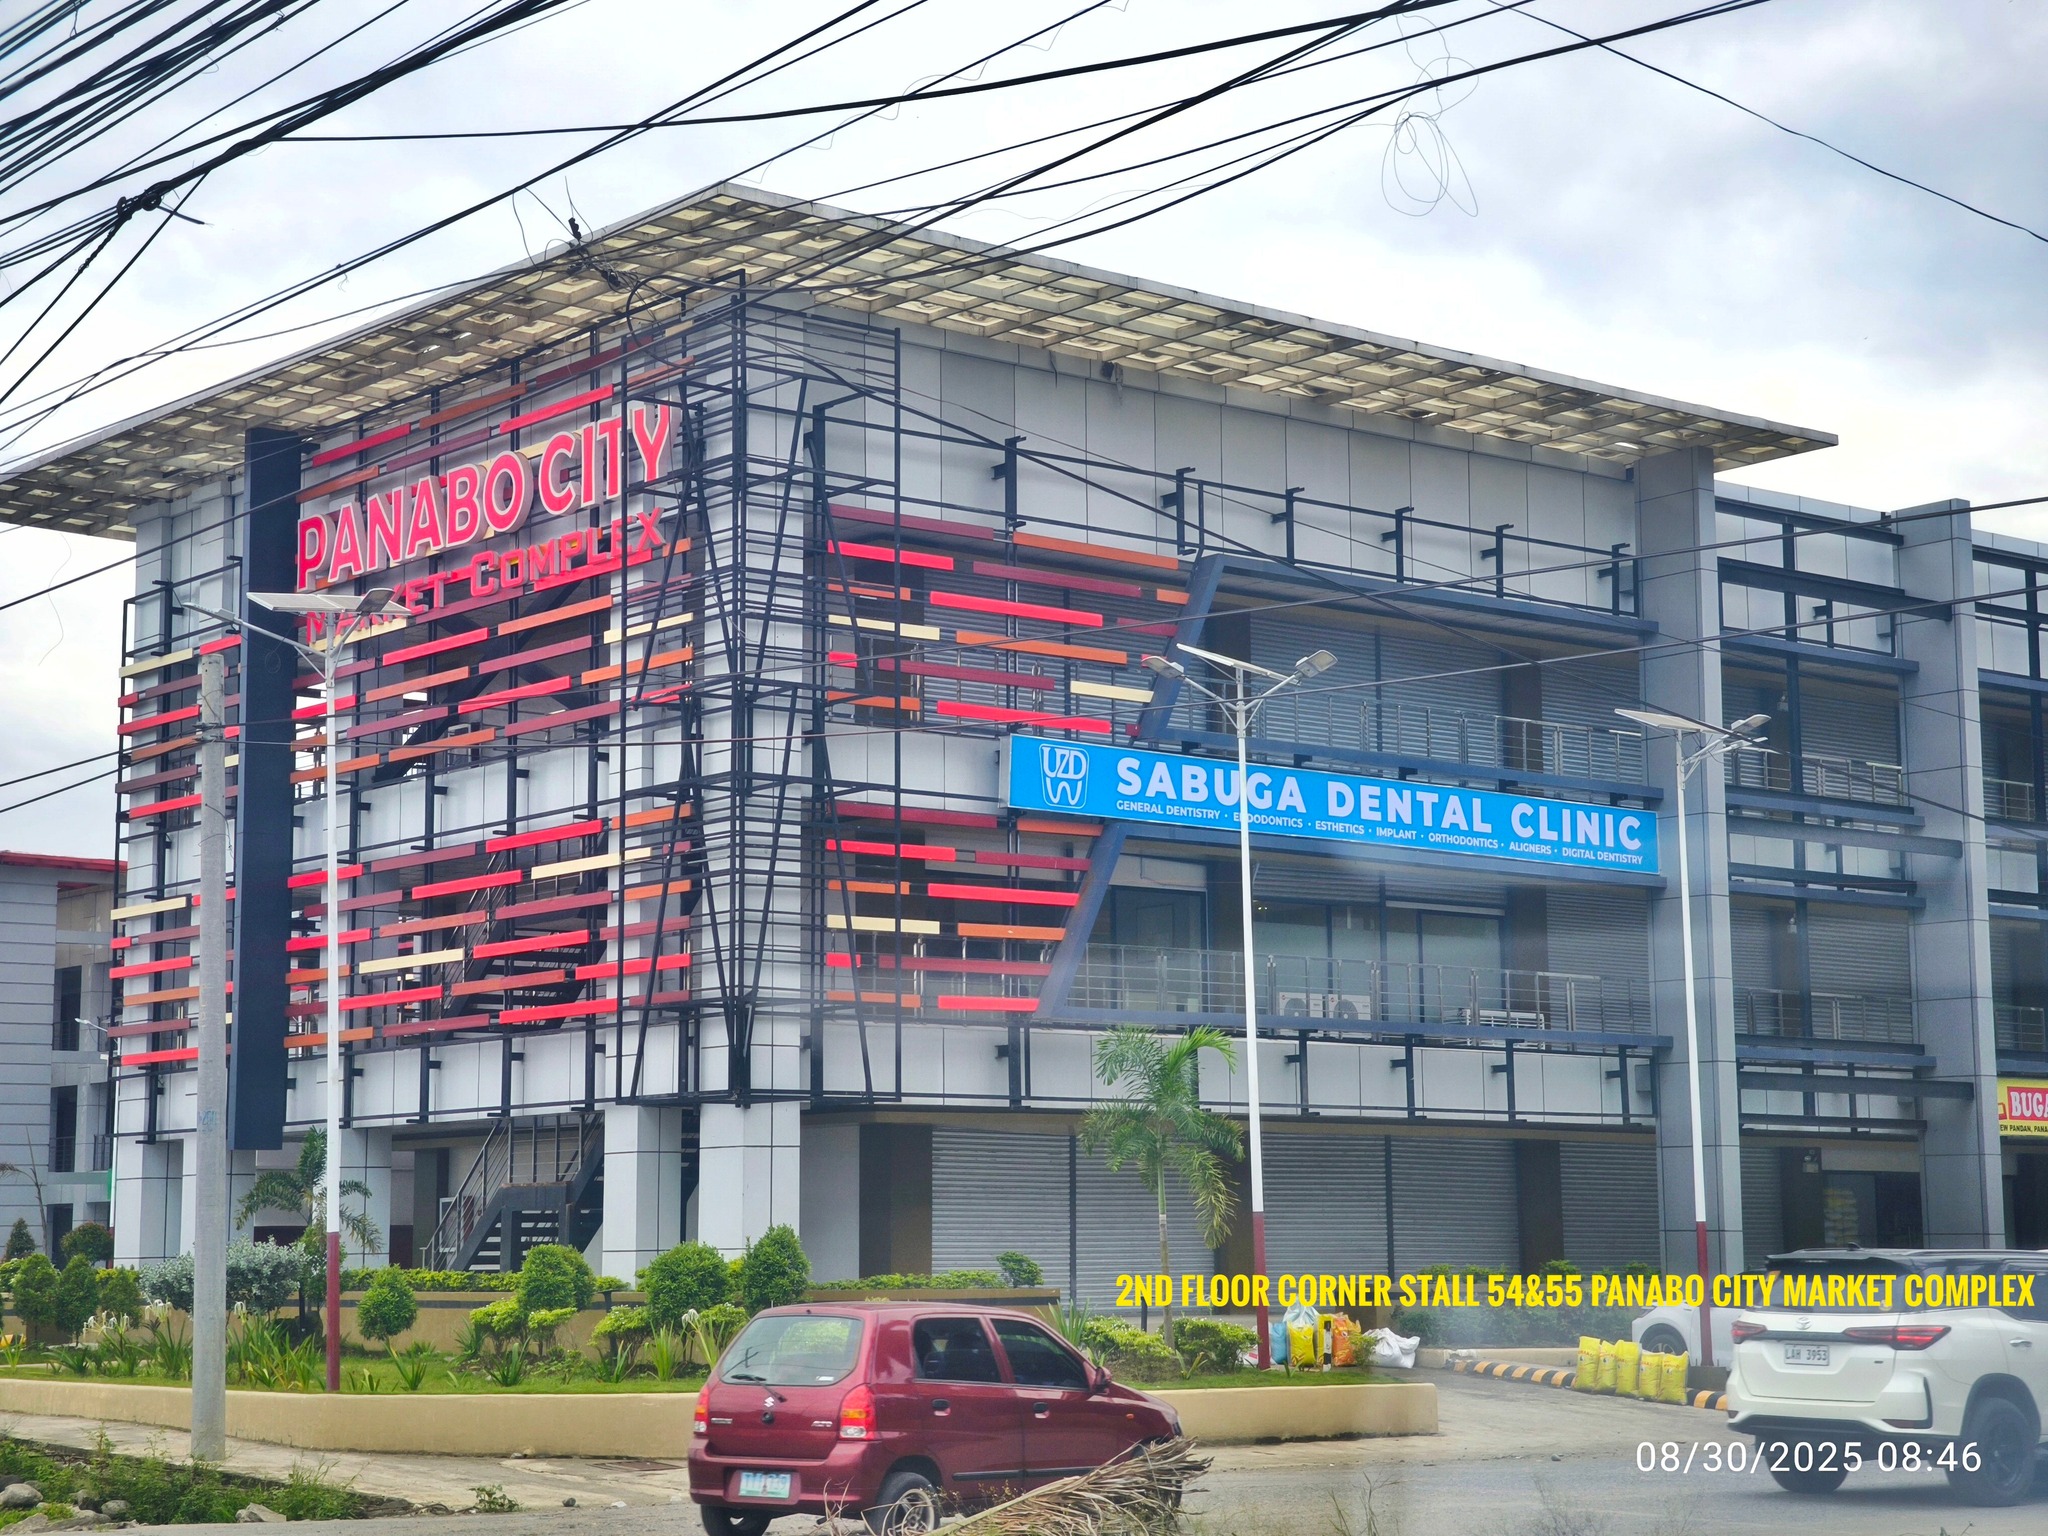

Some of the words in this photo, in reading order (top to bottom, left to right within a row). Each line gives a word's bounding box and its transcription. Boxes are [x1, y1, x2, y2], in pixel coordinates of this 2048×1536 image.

[297, 450, 531, 592] PANABO
[538, 404, 677, 516] CITY
[470, 507, 663, 597] COMPLEX
[1116, 757, 1307, 814] SABUGA
[1327, 781, 1492, 833] DENTAL
[1511, 802, 1642, 851] CLINIC
[1116, 800, 1164, 815] GENERAL
[1166, 806, 1220, 820] DENTISTRY
[1233, 812, 1303, 829] EDODONTICS
[1315, 820, 1364, 835] ESTHETICS
[1376, 826, 1417, 841] IMPLANT
[1428, 832, 1498, 849] ORTHODONTICS
[1509, 841, 1552, 855] ALIGNERS
[1562, 847, 1596, 861] DIGITAL
[1597, 852, 1644, 865] DENTISTRY
